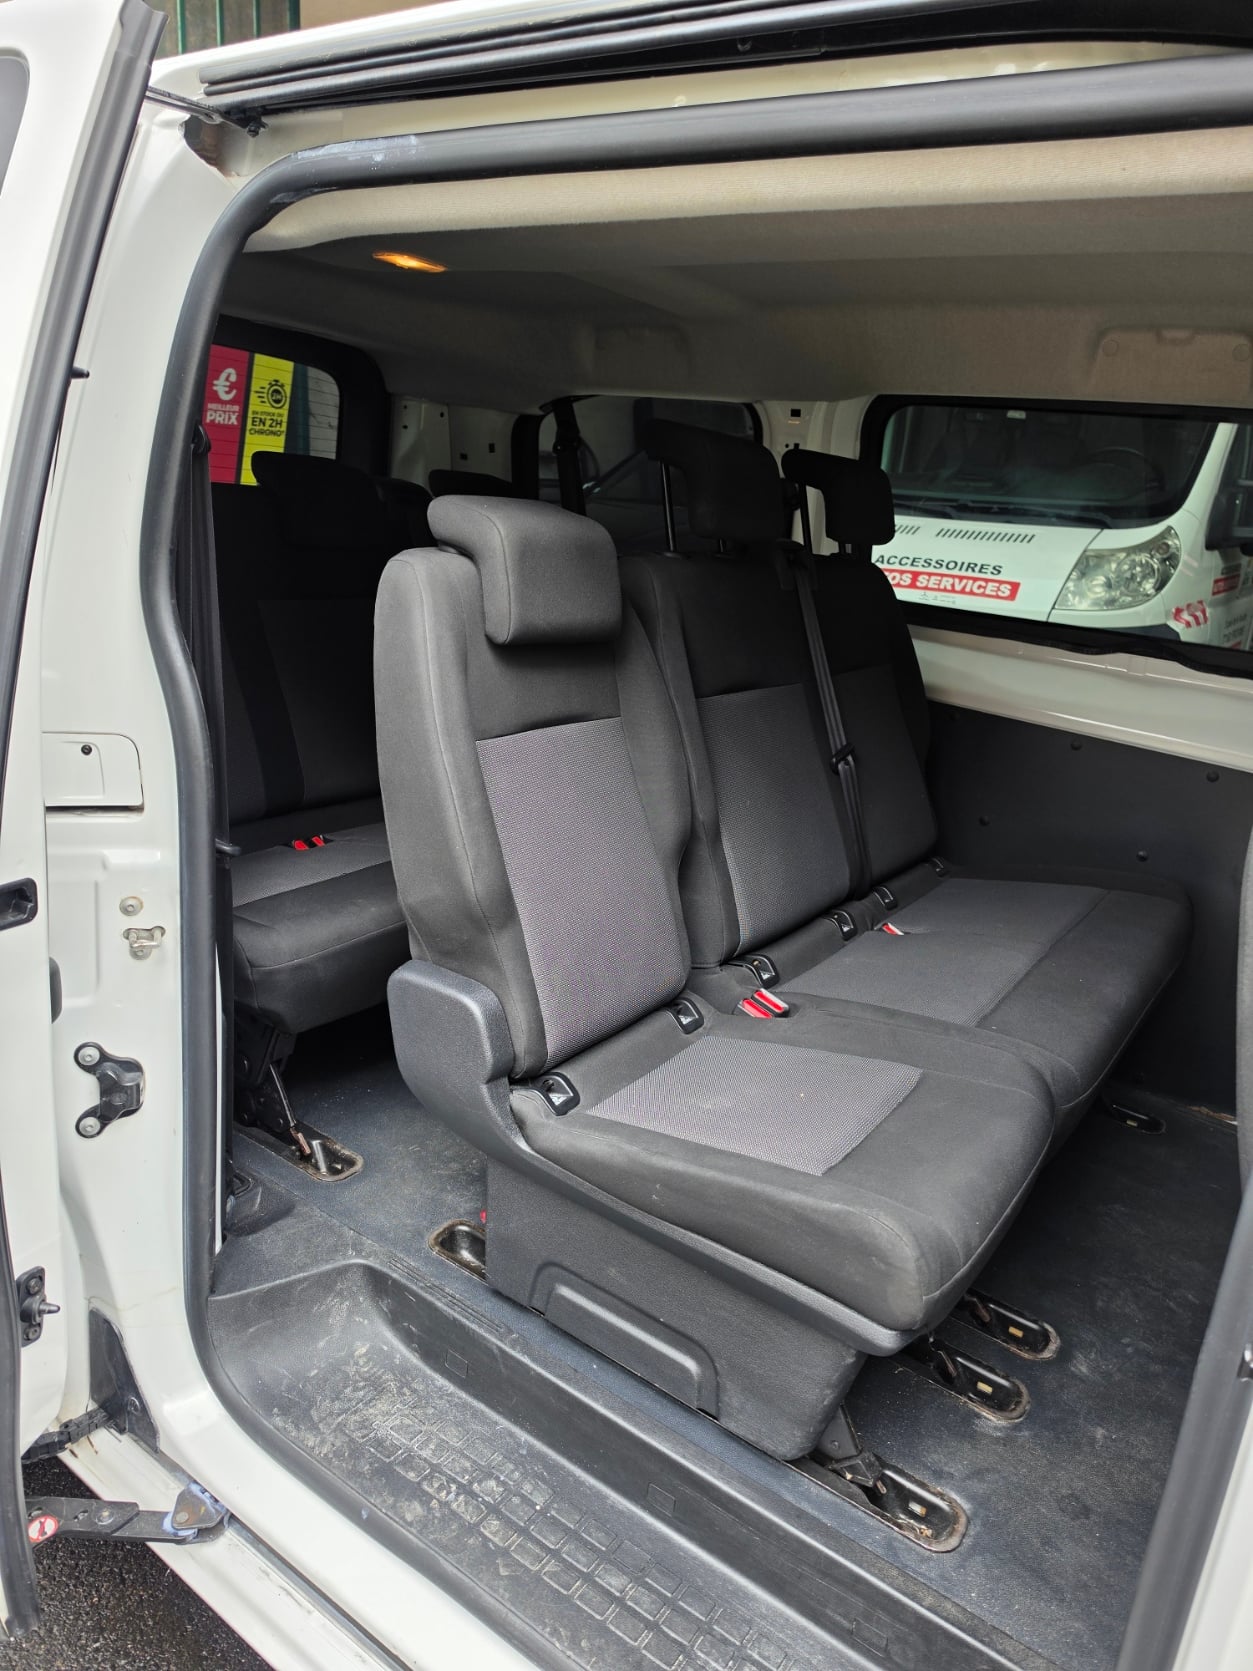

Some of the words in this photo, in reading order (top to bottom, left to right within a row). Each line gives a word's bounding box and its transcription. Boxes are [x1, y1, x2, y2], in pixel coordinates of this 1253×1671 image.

[206, 411, 239, 425] PRIX
[251, 416, 266, 427] EN
[269, 417, 283, 429] 2H
[874, 554, 1004, 576] ACCESSOIRES
[915, 574, 1012, 598] SERVICES
